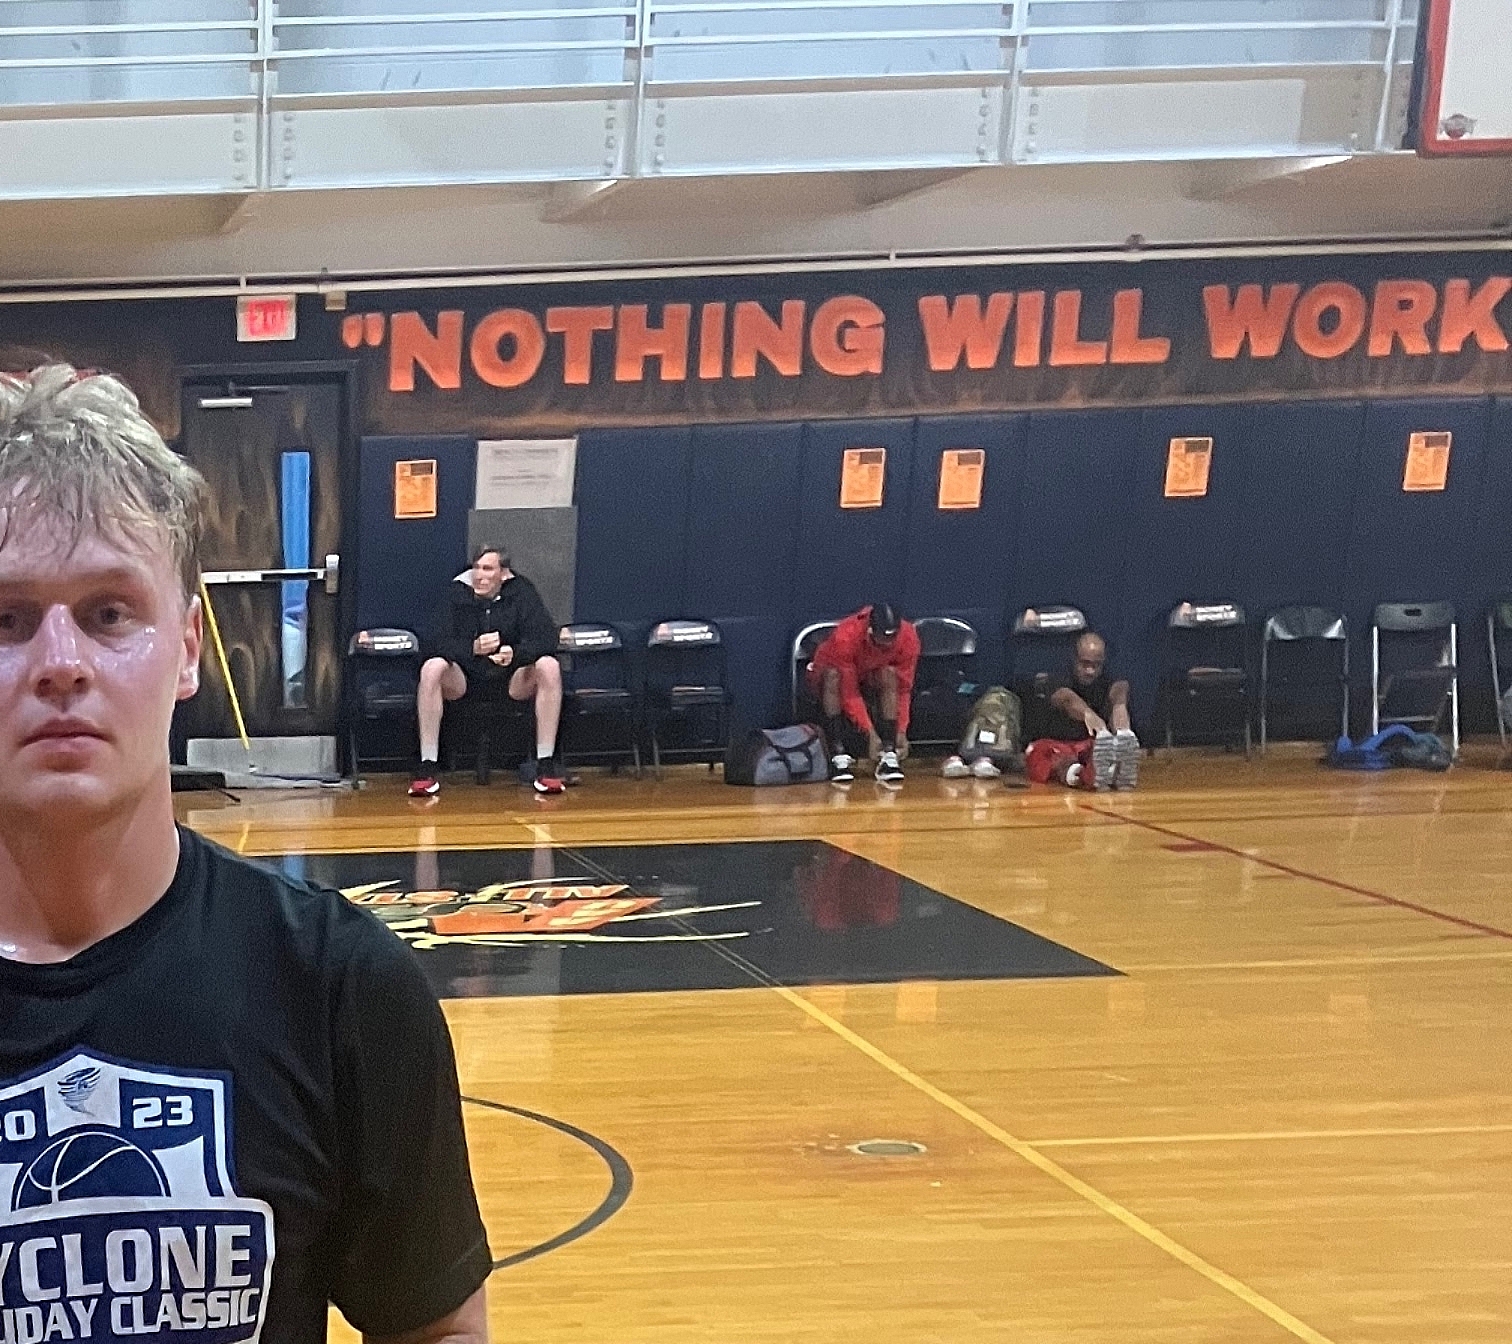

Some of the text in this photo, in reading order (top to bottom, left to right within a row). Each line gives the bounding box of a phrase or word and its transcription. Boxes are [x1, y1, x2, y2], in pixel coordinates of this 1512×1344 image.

[918, 287, 1172, 371] WILL
[1201, 275, 1512, 359] WORK
[131, 1095, 194, 1129] 23
[109, 1286, 262, 1336] CLASSIC
